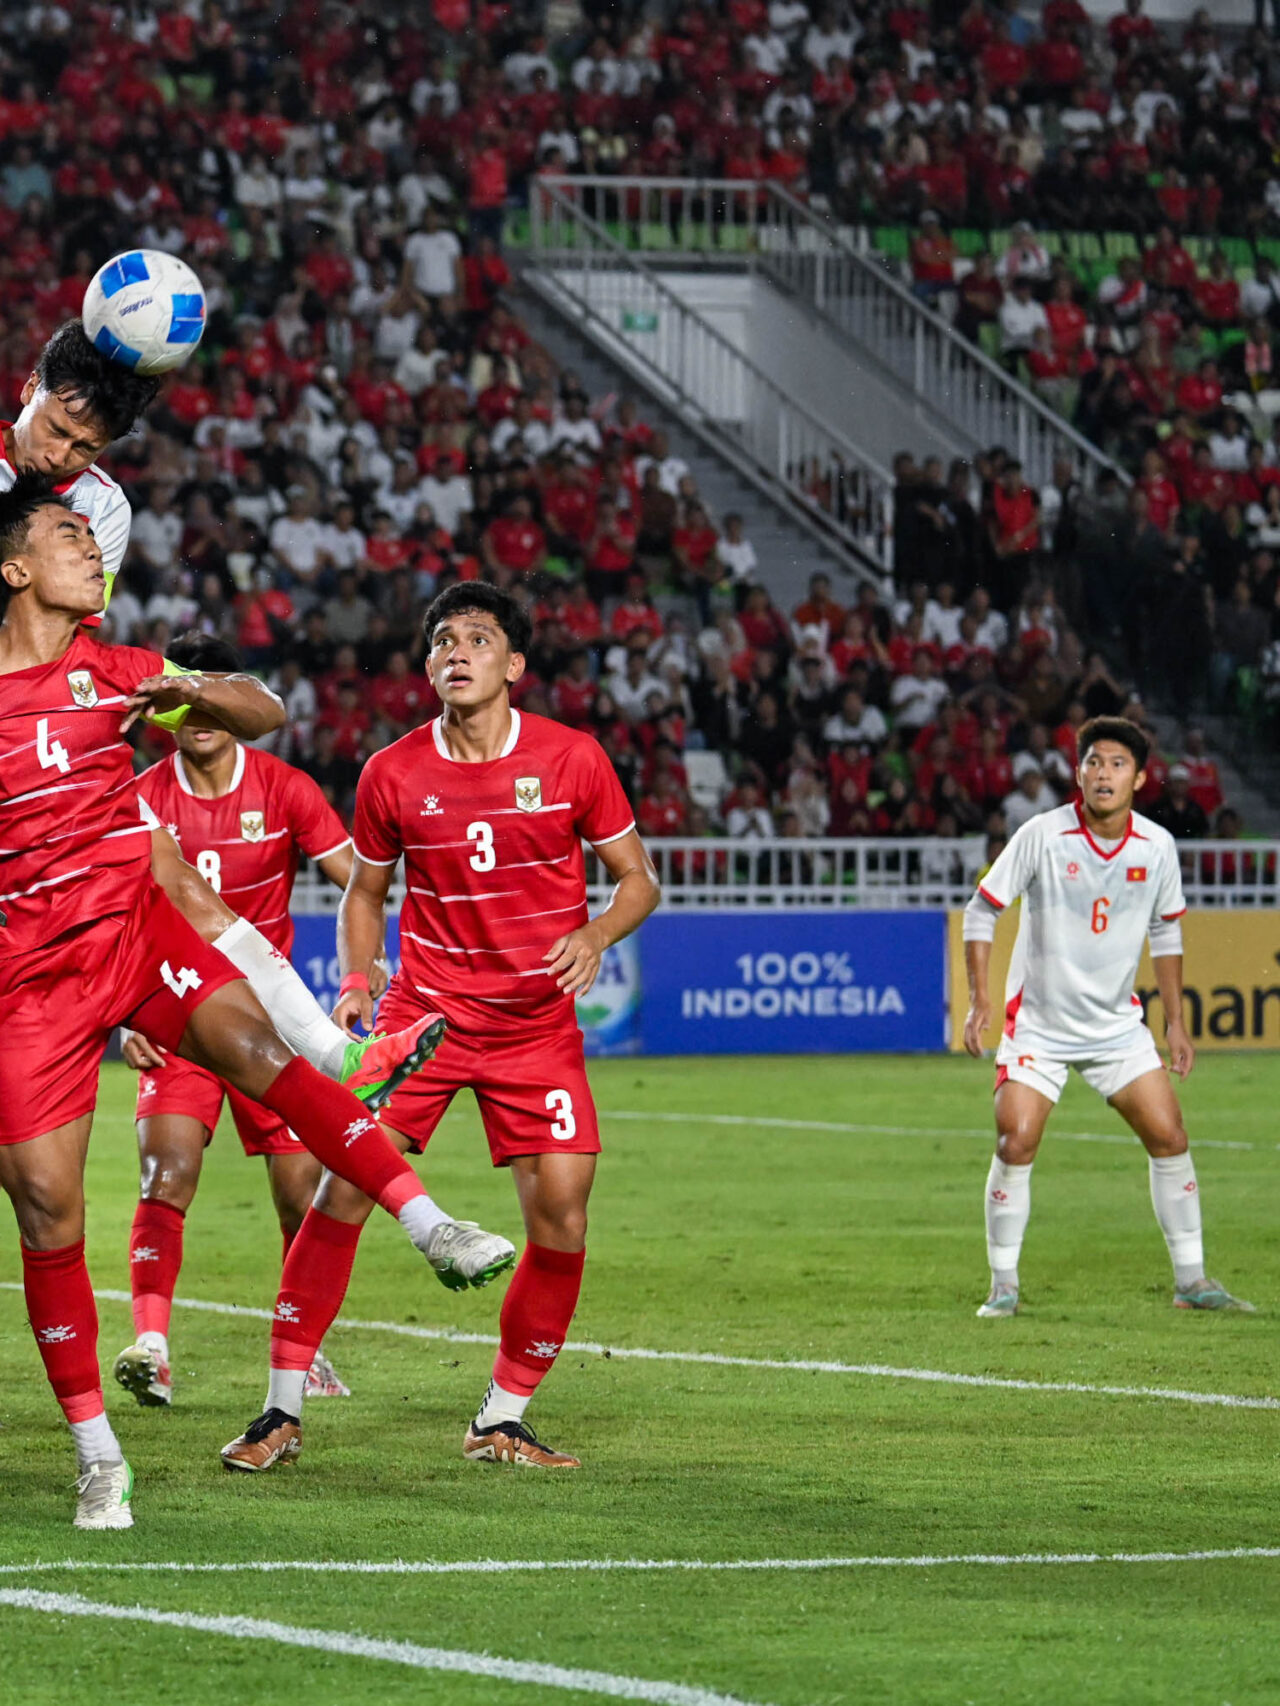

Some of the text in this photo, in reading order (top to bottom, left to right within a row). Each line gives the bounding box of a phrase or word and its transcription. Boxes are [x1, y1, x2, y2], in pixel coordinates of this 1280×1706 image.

[36, 717, 71, 774] 4
[420, 808, 444, 816] KELME
[466, 821, 496, 872] 3
[196, 850, 221, 894] 8
[1091, 896, 1110, 935] 6
[159, 960, 203, 999] 4
[735, 951, 854, 985] 100%
[681, 985, 906, 1018] INDONESIA
[545, 1089, 576, 1140] 3
